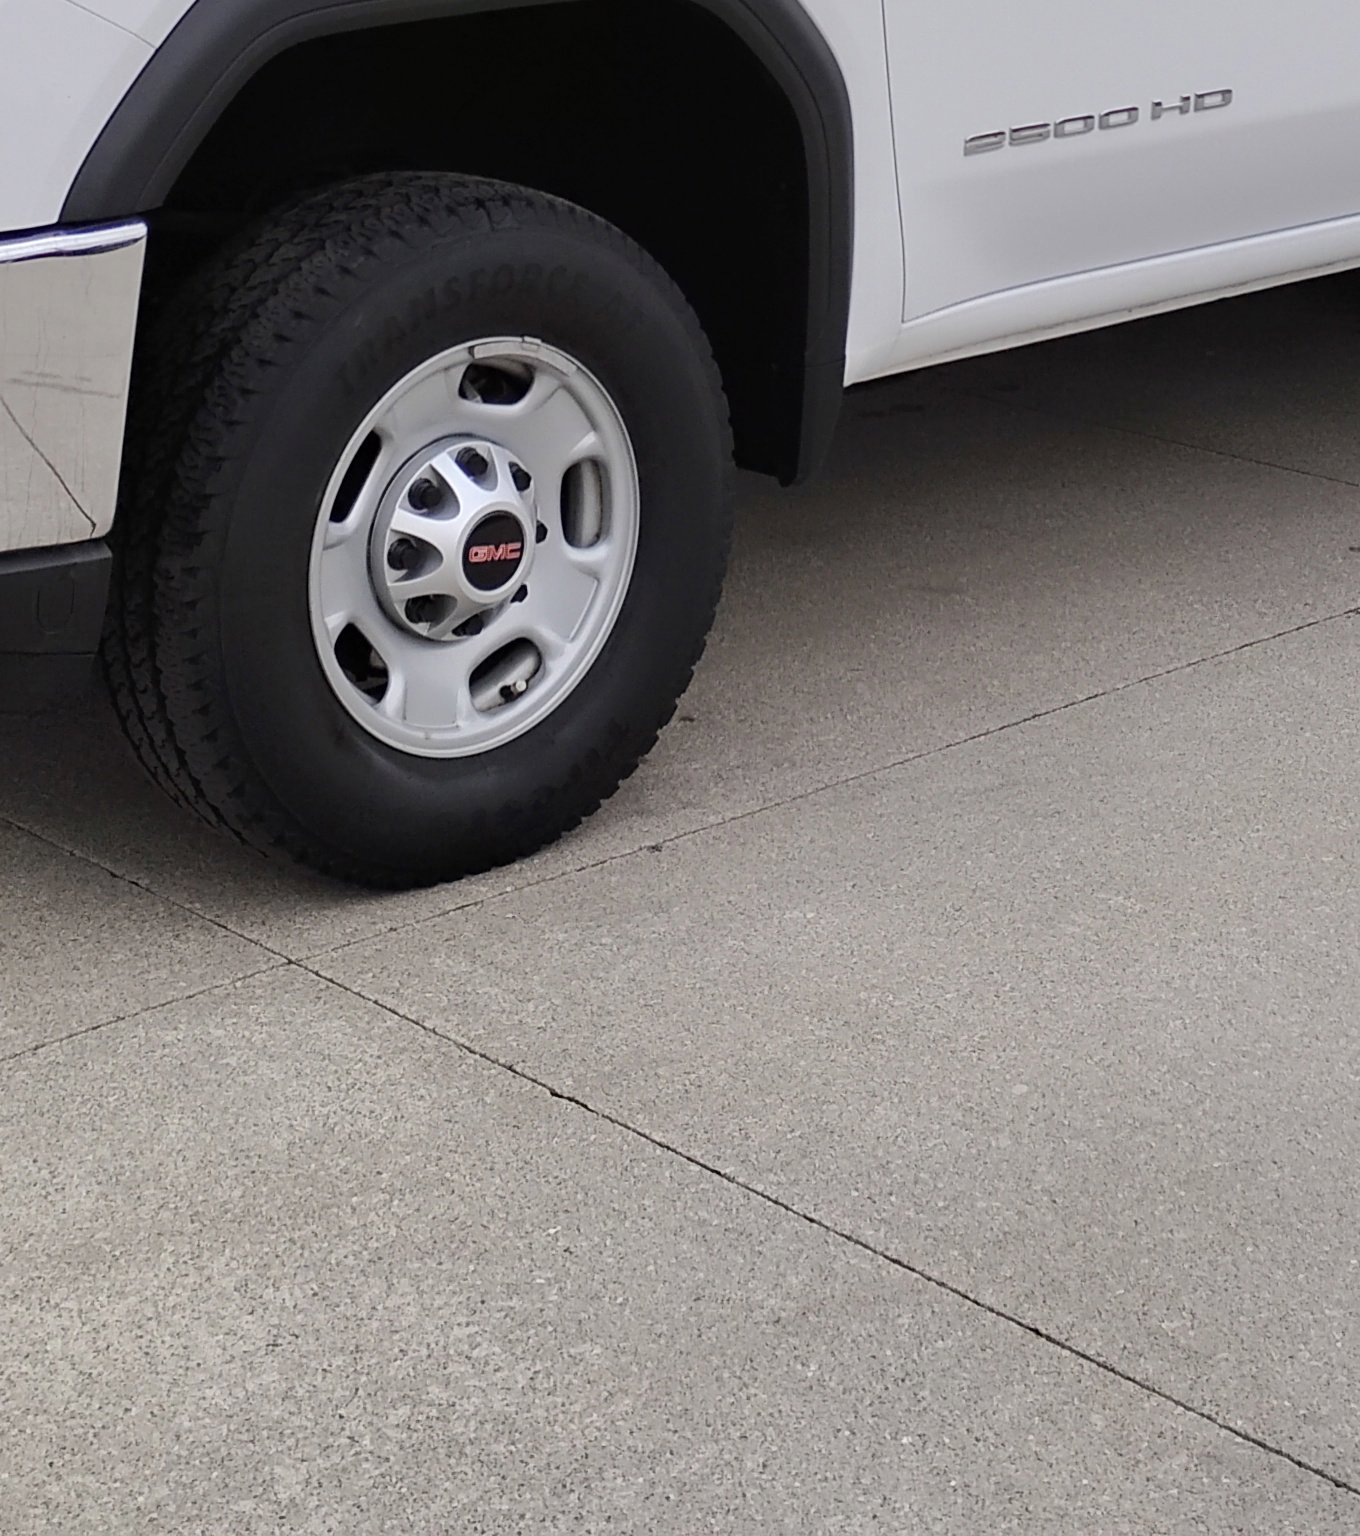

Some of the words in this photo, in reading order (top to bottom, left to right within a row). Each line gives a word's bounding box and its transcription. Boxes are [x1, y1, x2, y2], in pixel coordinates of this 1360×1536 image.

[963, 106, 1140, 157] 2500
[1150, 88, 1233, 121] HD
[468, 541, 522, 563] GMC
